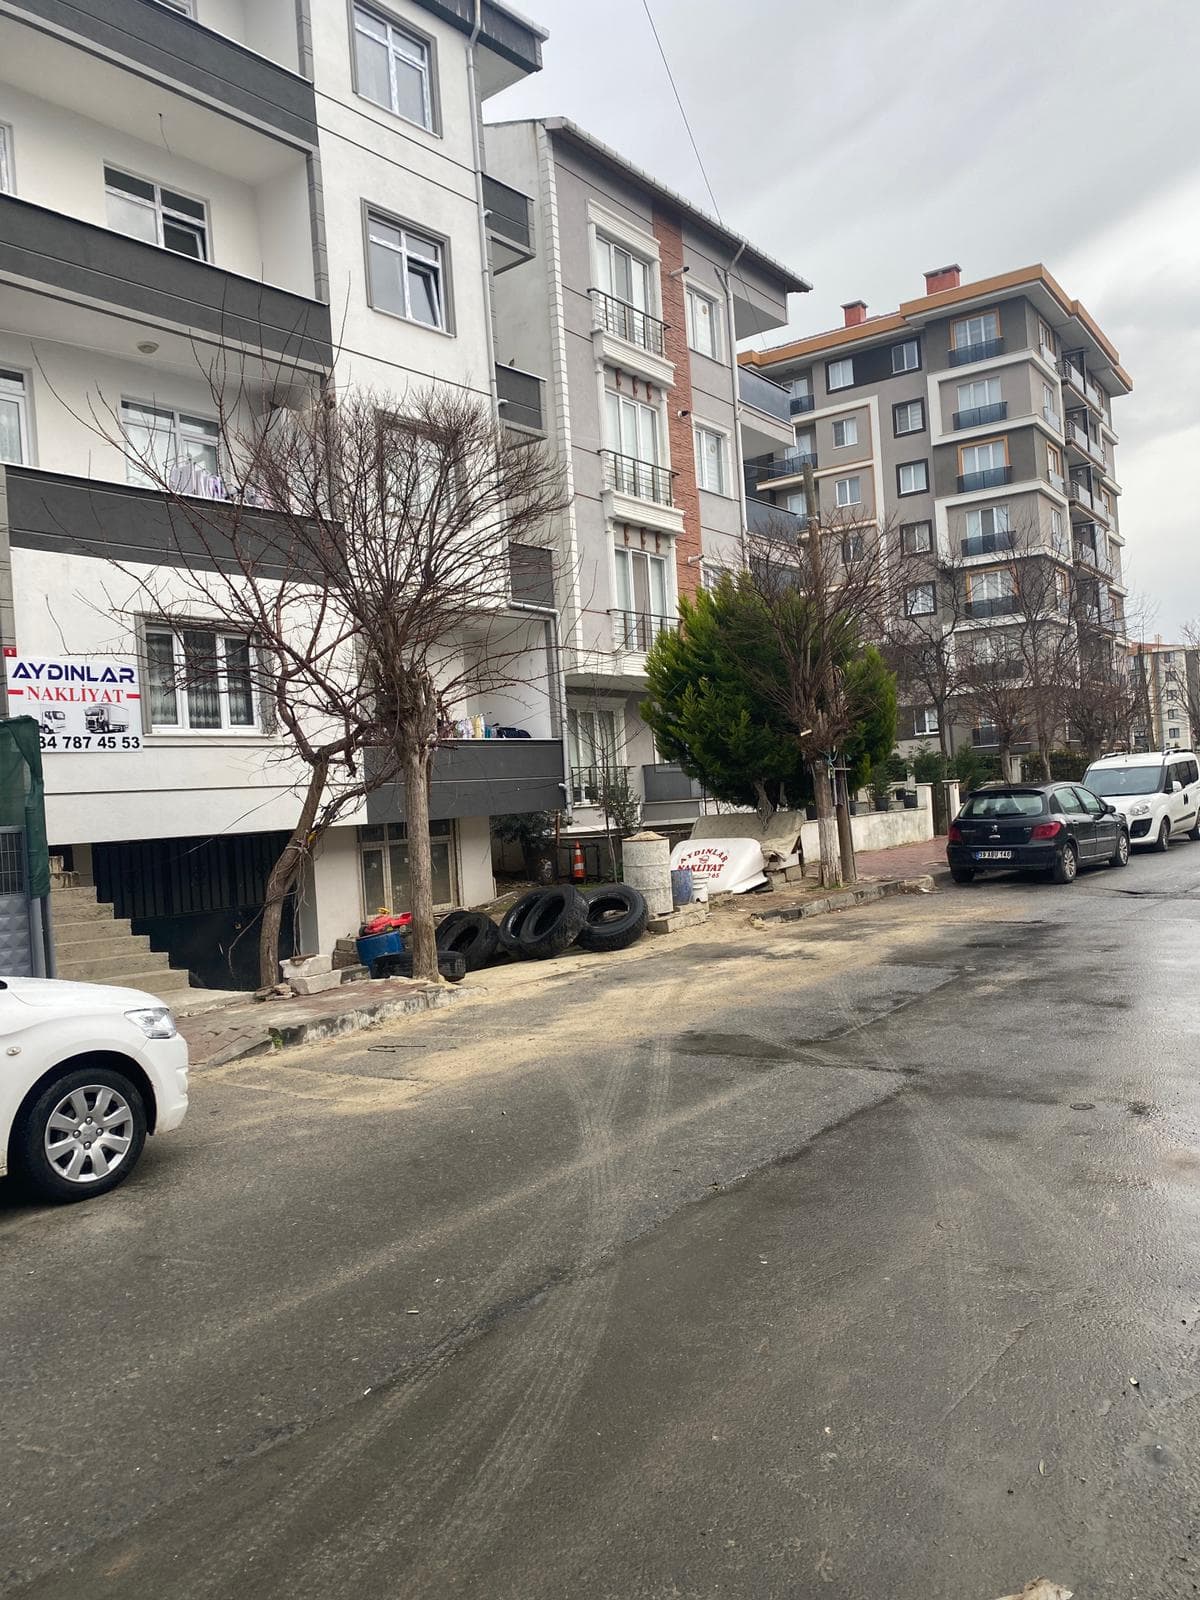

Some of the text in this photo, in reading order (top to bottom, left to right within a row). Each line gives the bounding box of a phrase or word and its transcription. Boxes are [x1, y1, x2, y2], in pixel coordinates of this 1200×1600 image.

[12, 662, 135, 683] AYDINLAR
[27, 684, 124, 703] NAKLİYAT
[62, 736, 92, 749] 787
[97, 737, 117, 749] 45
[122, 737, 140, 749] 53
